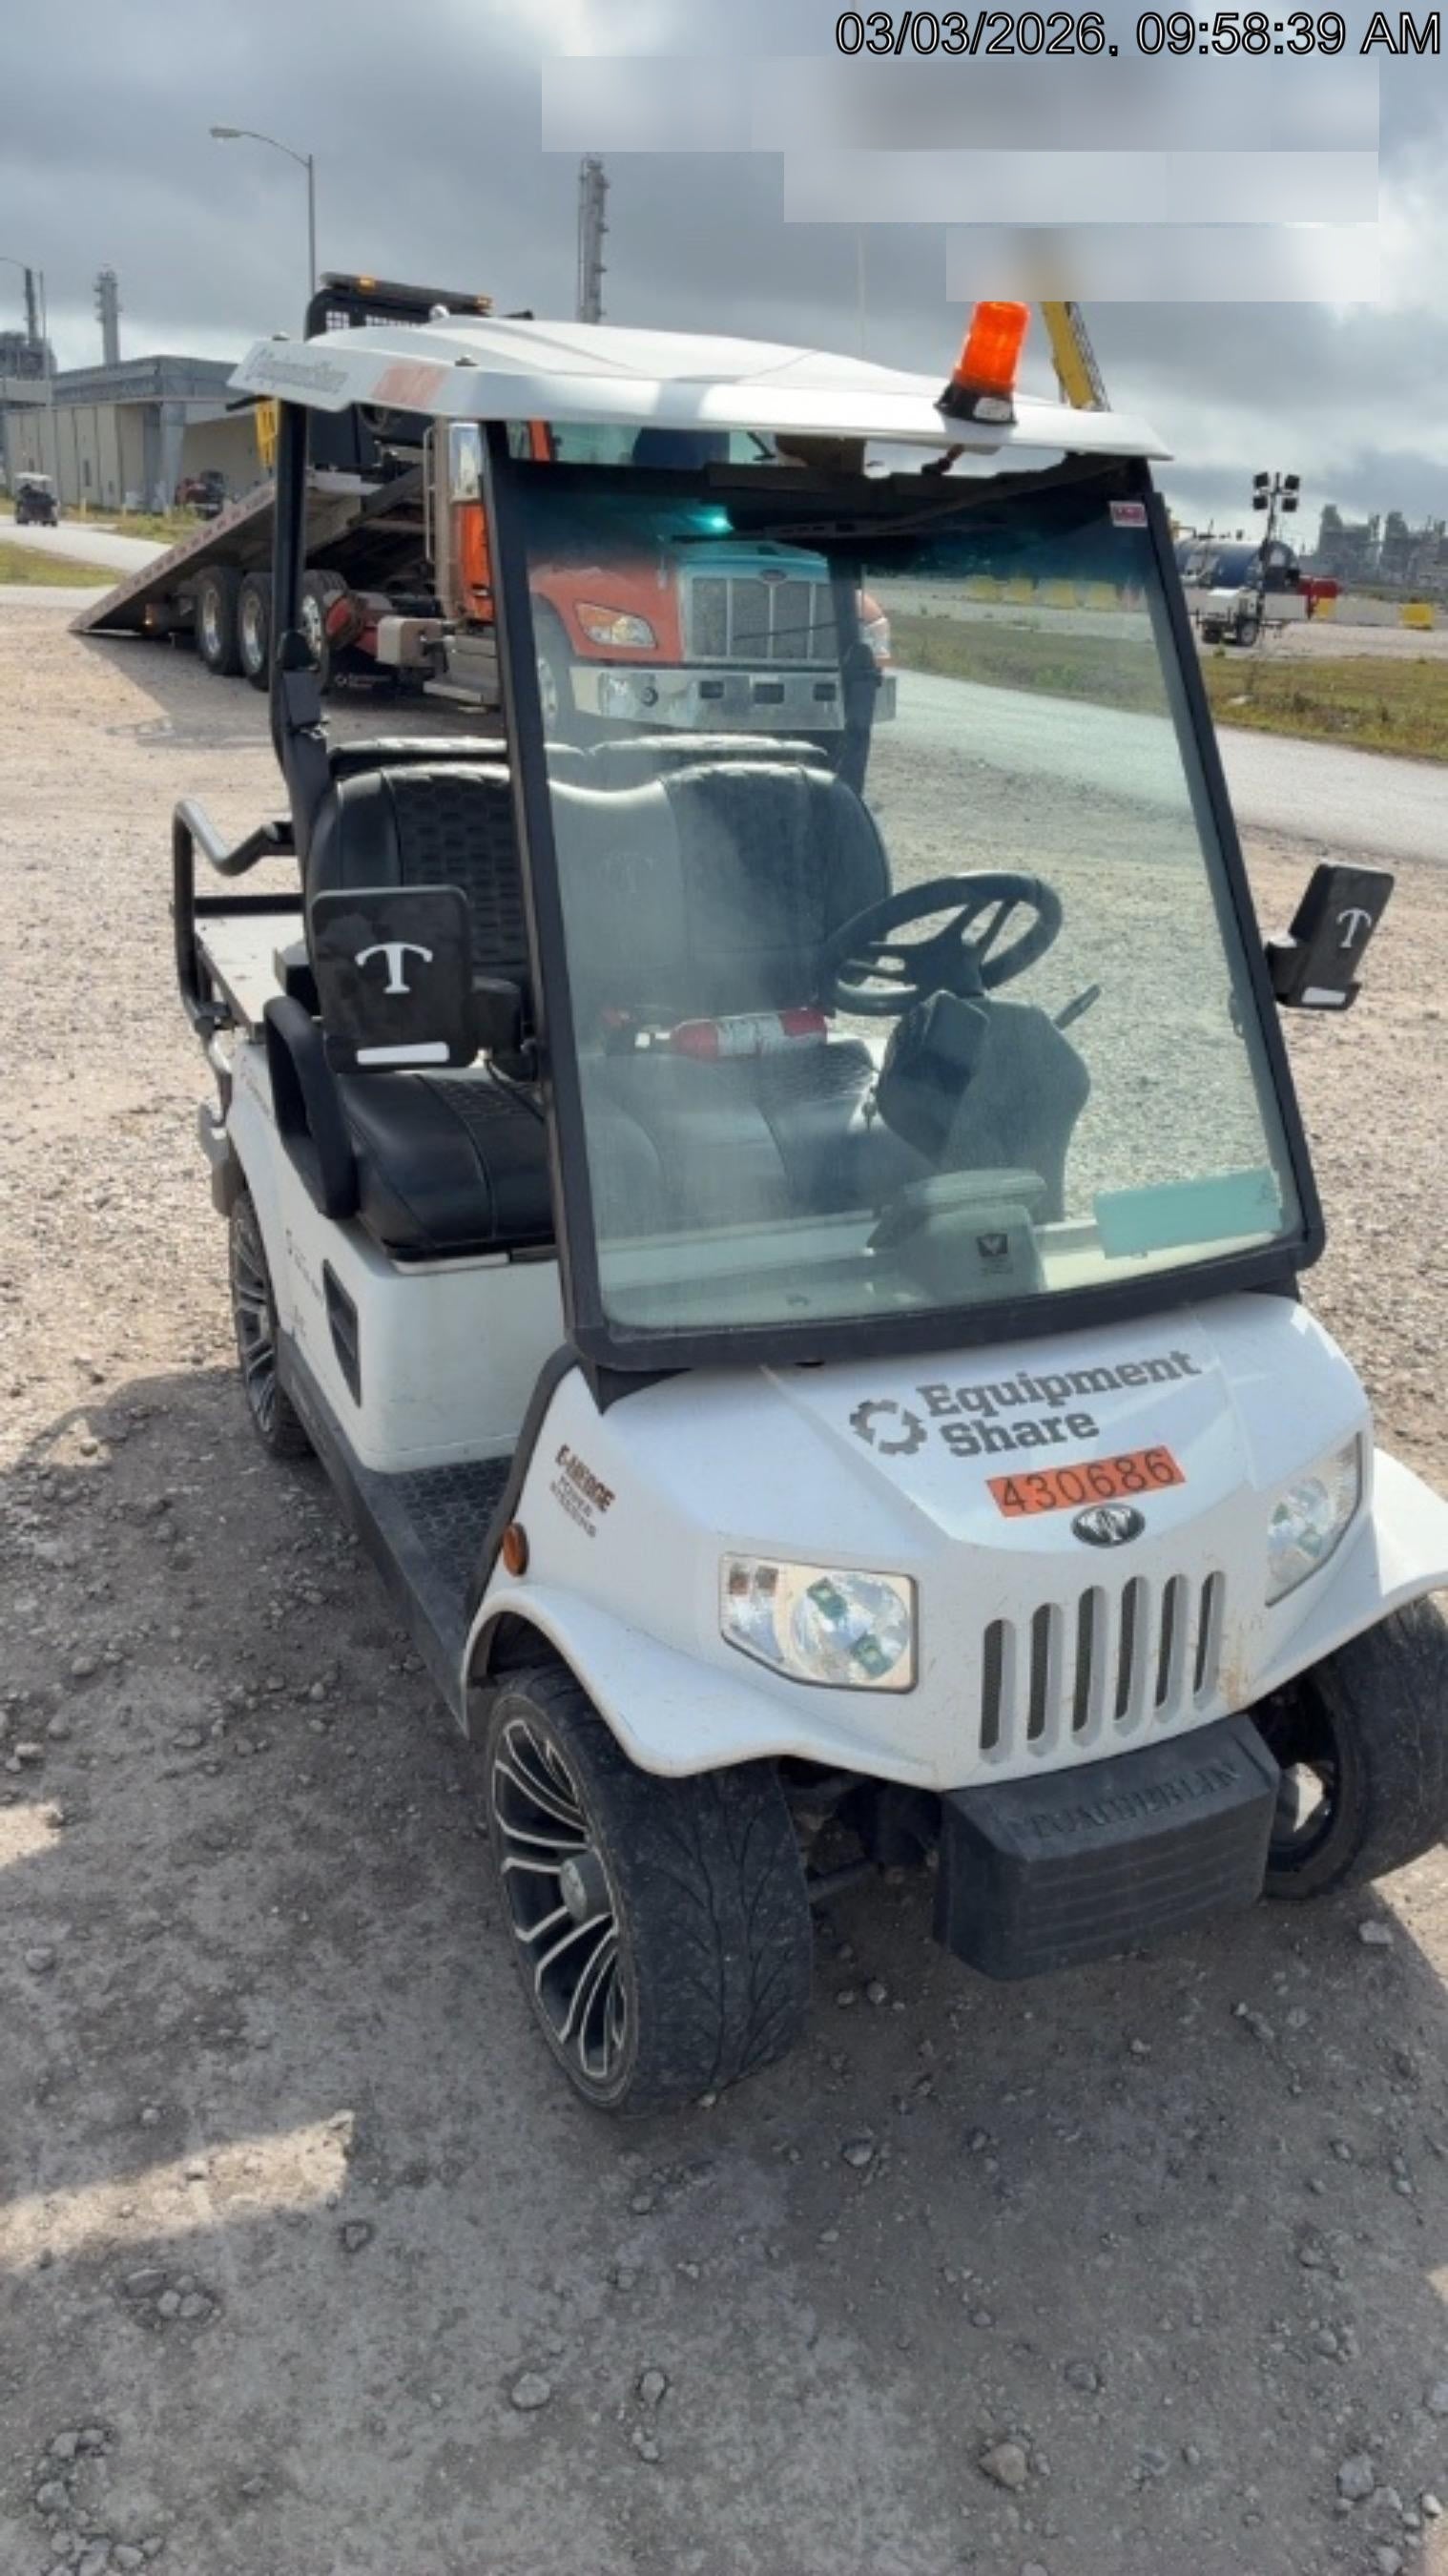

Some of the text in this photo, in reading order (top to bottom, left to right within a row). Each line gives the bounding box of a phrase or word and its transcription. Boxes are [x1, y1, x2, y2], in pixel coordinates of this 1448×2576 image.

[1336, 907, 1373, 948] T
[355, 941, 433, 993] T
[916, 1349, 1202, 1418] Equipment
[939, 1412, 1101, 1457] Share
[1003, 1448, 1175, 1512] 430686
